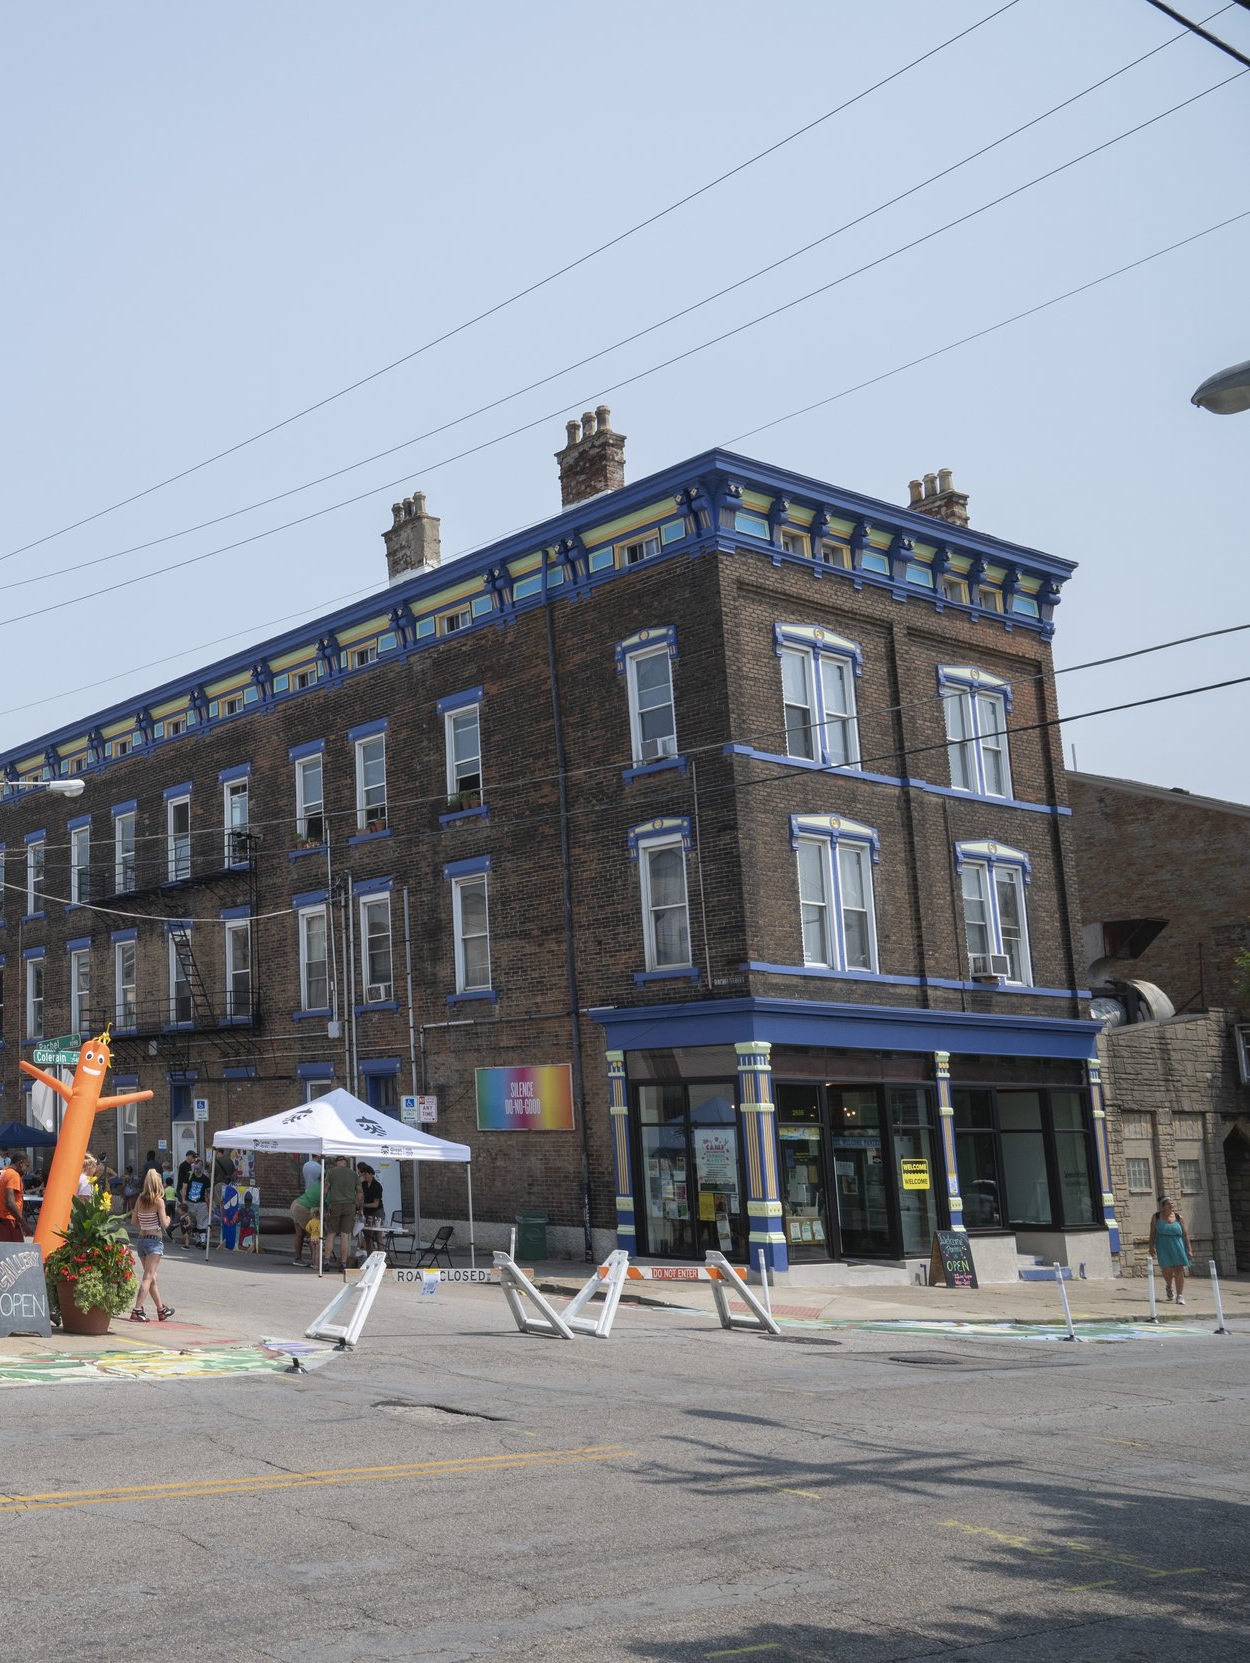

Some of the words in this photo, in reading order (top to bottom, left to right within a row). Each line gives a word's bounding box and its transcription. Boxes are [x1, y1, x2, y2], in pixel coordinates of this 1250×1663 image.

[38, 1039, 60, 1051] Rachel
[36, 1051, 67, 1063] Colerain
[510, 1081, 534, 1098] SILENCE
[902, 1163, 927, 1171] WELCOME
[946, 1260, 970, 1273] OPEN
[397, 1270, 423, 1282] ROA
[439, 1270, 486, 1282] CLOSED
[653, 1268, 663, 1278] DO
[664, 1268, 676, 1278] NOT
[677, 1269, 698, 1278] ENTER
